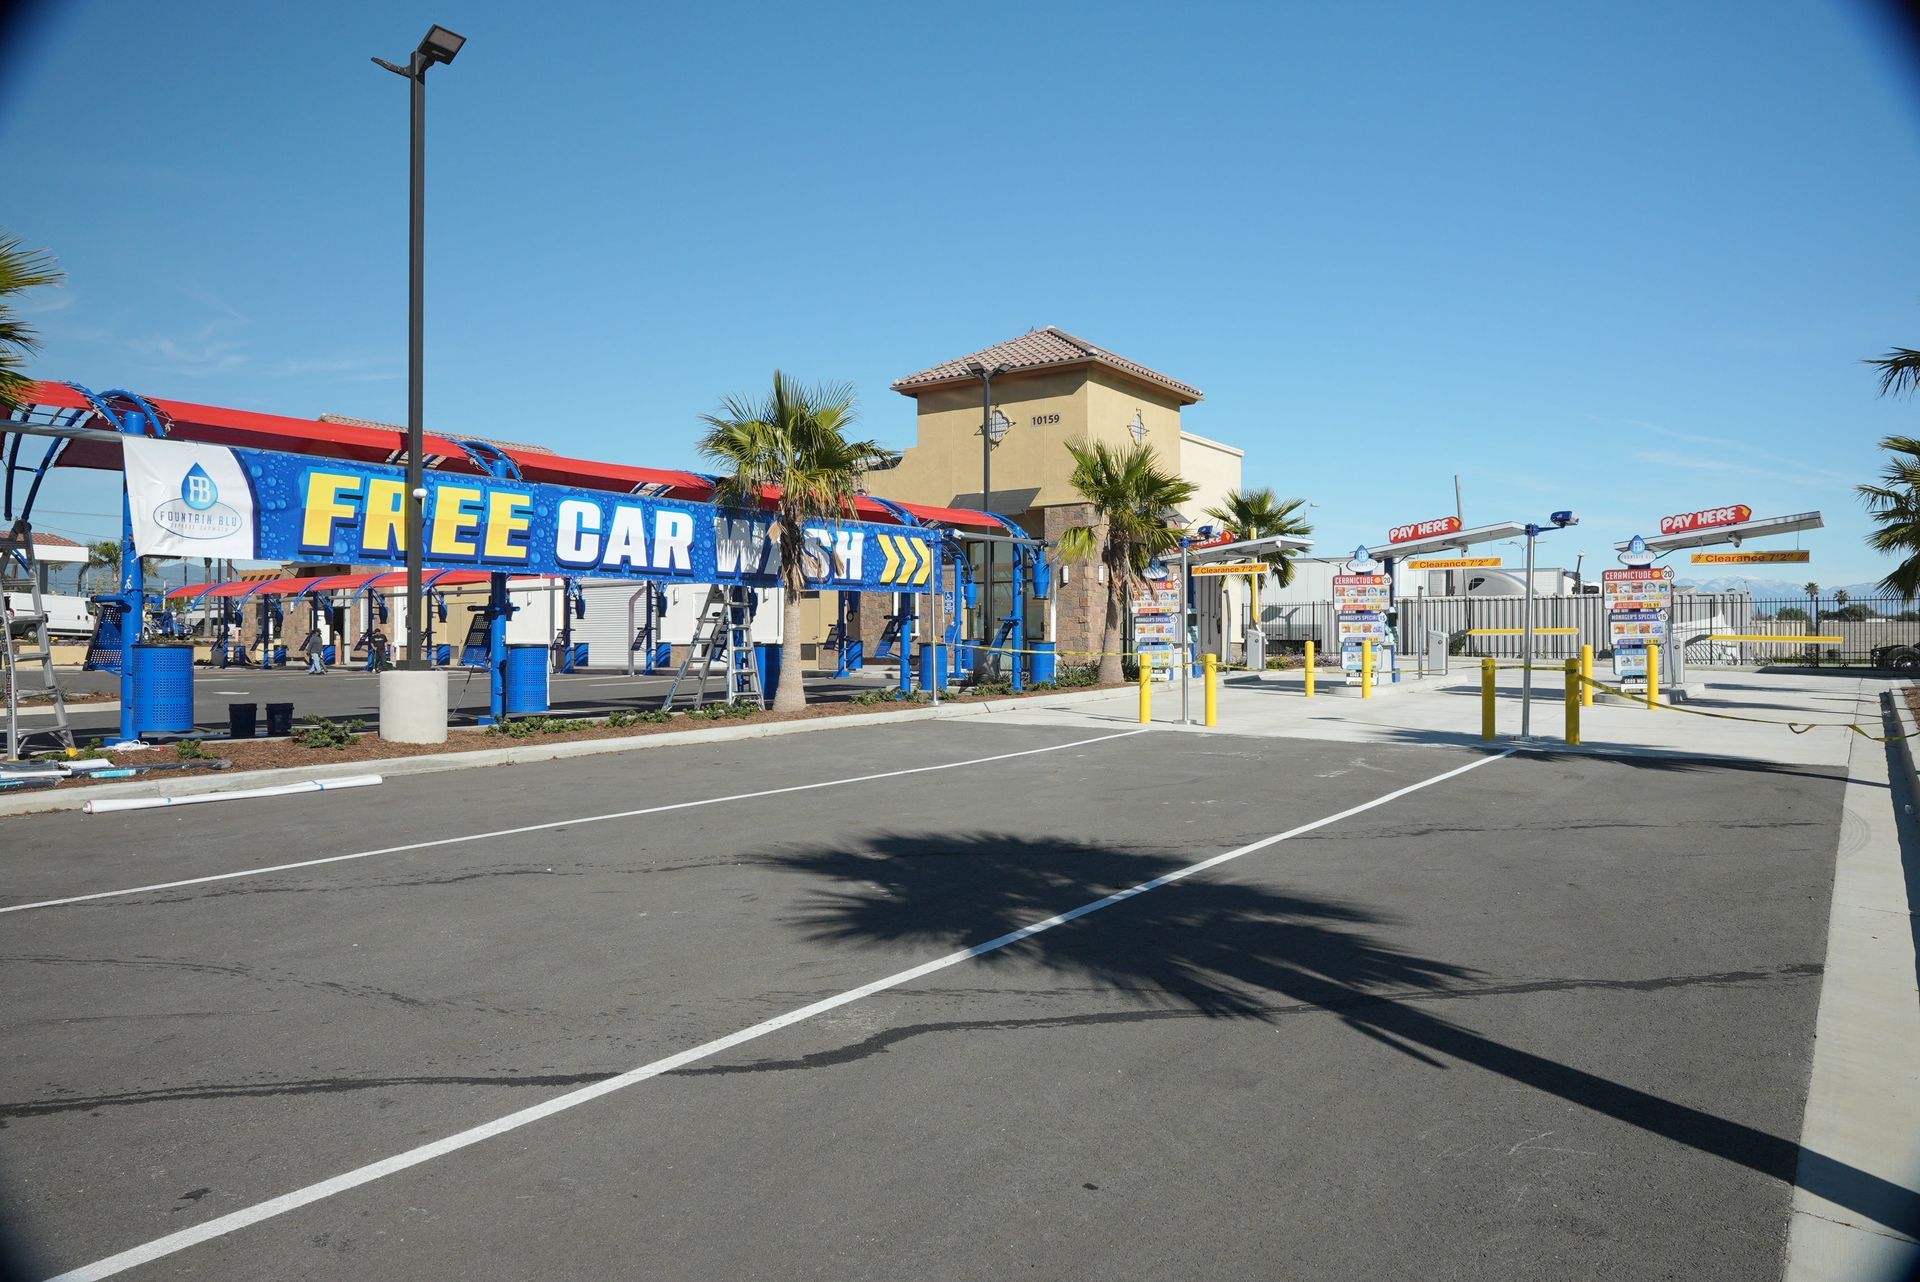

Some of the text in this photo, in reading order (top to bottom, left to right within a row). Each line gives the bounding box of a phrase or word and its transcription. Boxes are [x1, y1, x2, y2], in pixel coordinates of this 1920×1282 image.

[1032, 414, 1060, 426] 10159
[188, 475, 211, 503] FB
[160, 510, 238, 527] FOUNTAIN BLU
[302, 472, 531, 560] FREE
[555, 500, 694, 570] CAR
[1662, 507, 1737, 531] PAY HERE
[1390, 518, 1449, 541] PAY HERE
[1705, 553, 1765, 563] Clearance
[1200, 566, 1239, 575] Clearance
[1419, 560, 1466, 569] Clearance
[1335, 576, 1373, 585] CERAMICTUDE
[1605, 571, 1652, 580] CERAMICTUDE
